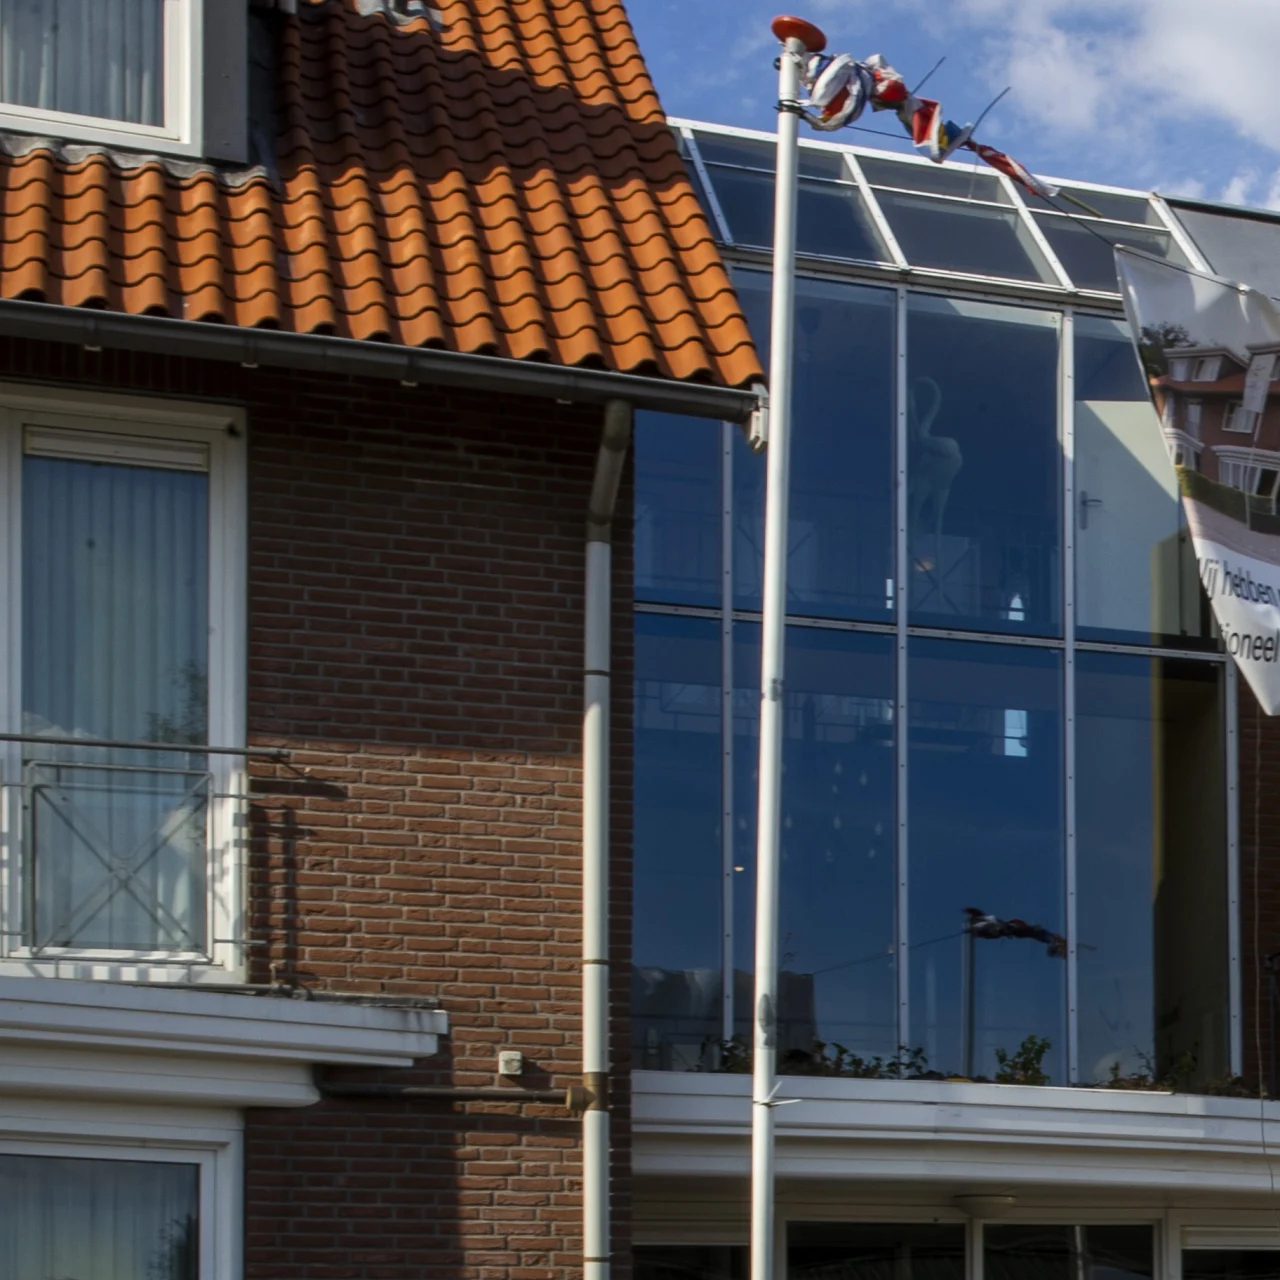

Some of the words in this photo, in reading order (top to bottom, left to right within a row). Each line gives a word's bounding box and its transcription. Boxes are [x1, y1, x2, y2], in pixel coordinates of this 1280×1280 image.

[1200, 558, 1219, 600] ij
[1222, 560, 1278, 608] hebben
[1219, 622, 1280, 663] ioneel
